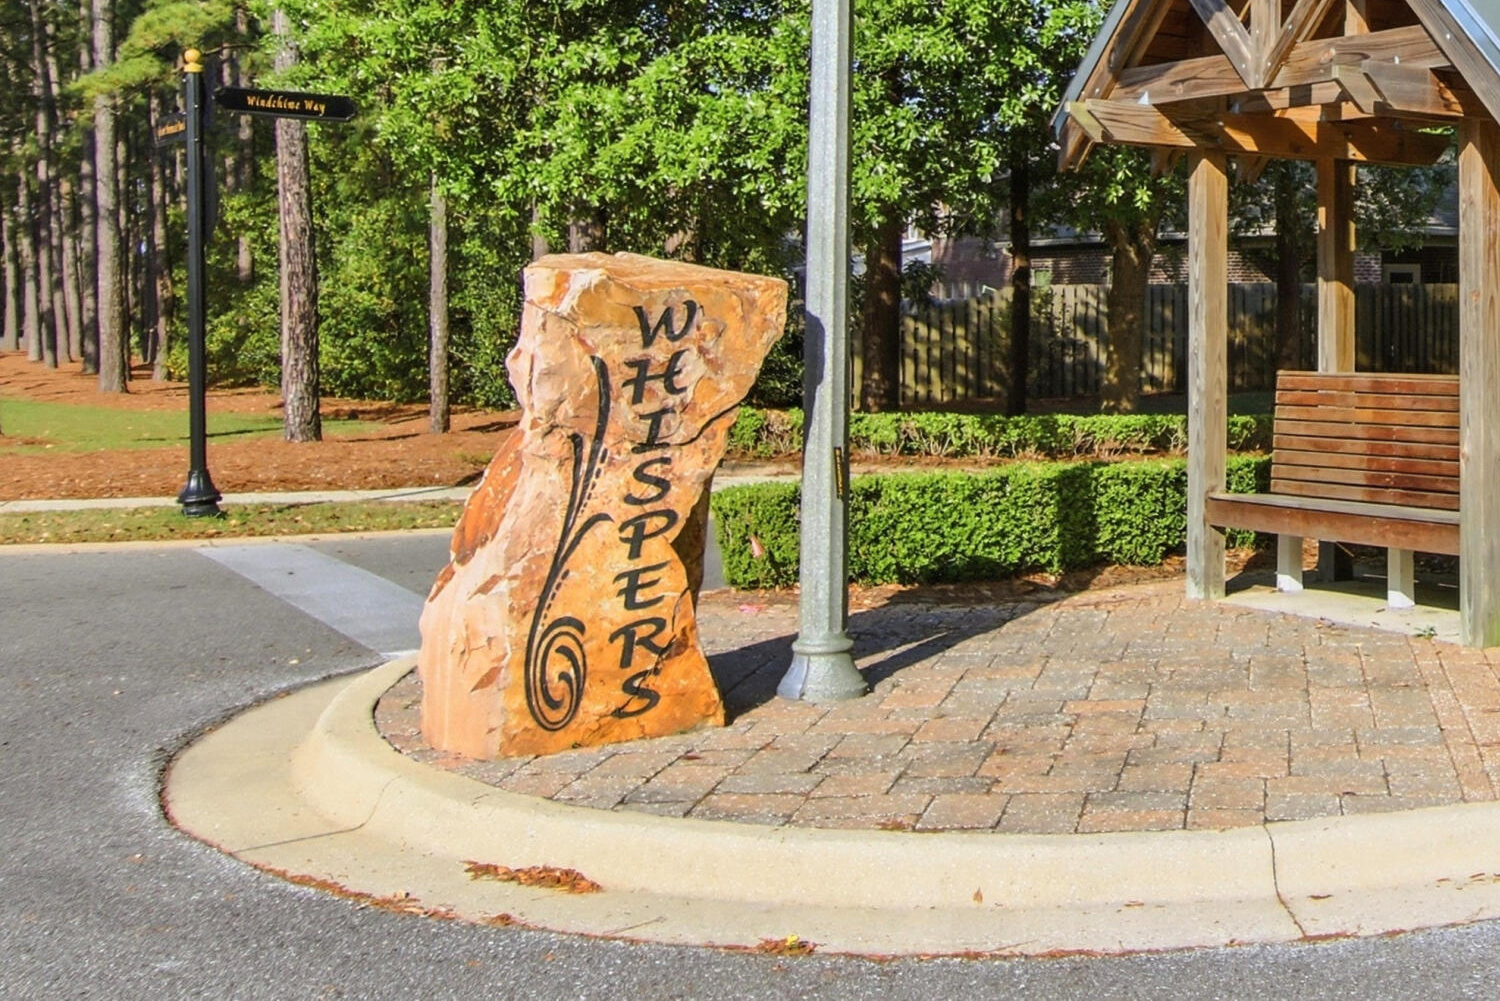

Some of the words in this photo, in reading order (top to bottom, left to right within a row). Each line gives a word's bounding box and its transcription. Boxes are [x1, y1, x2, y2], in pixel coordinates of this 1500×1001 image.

[246, 95, 301, 111] Windchime
[303, 100, 327, 116] Way
[609, 300, 700, 719] WHISPERS
